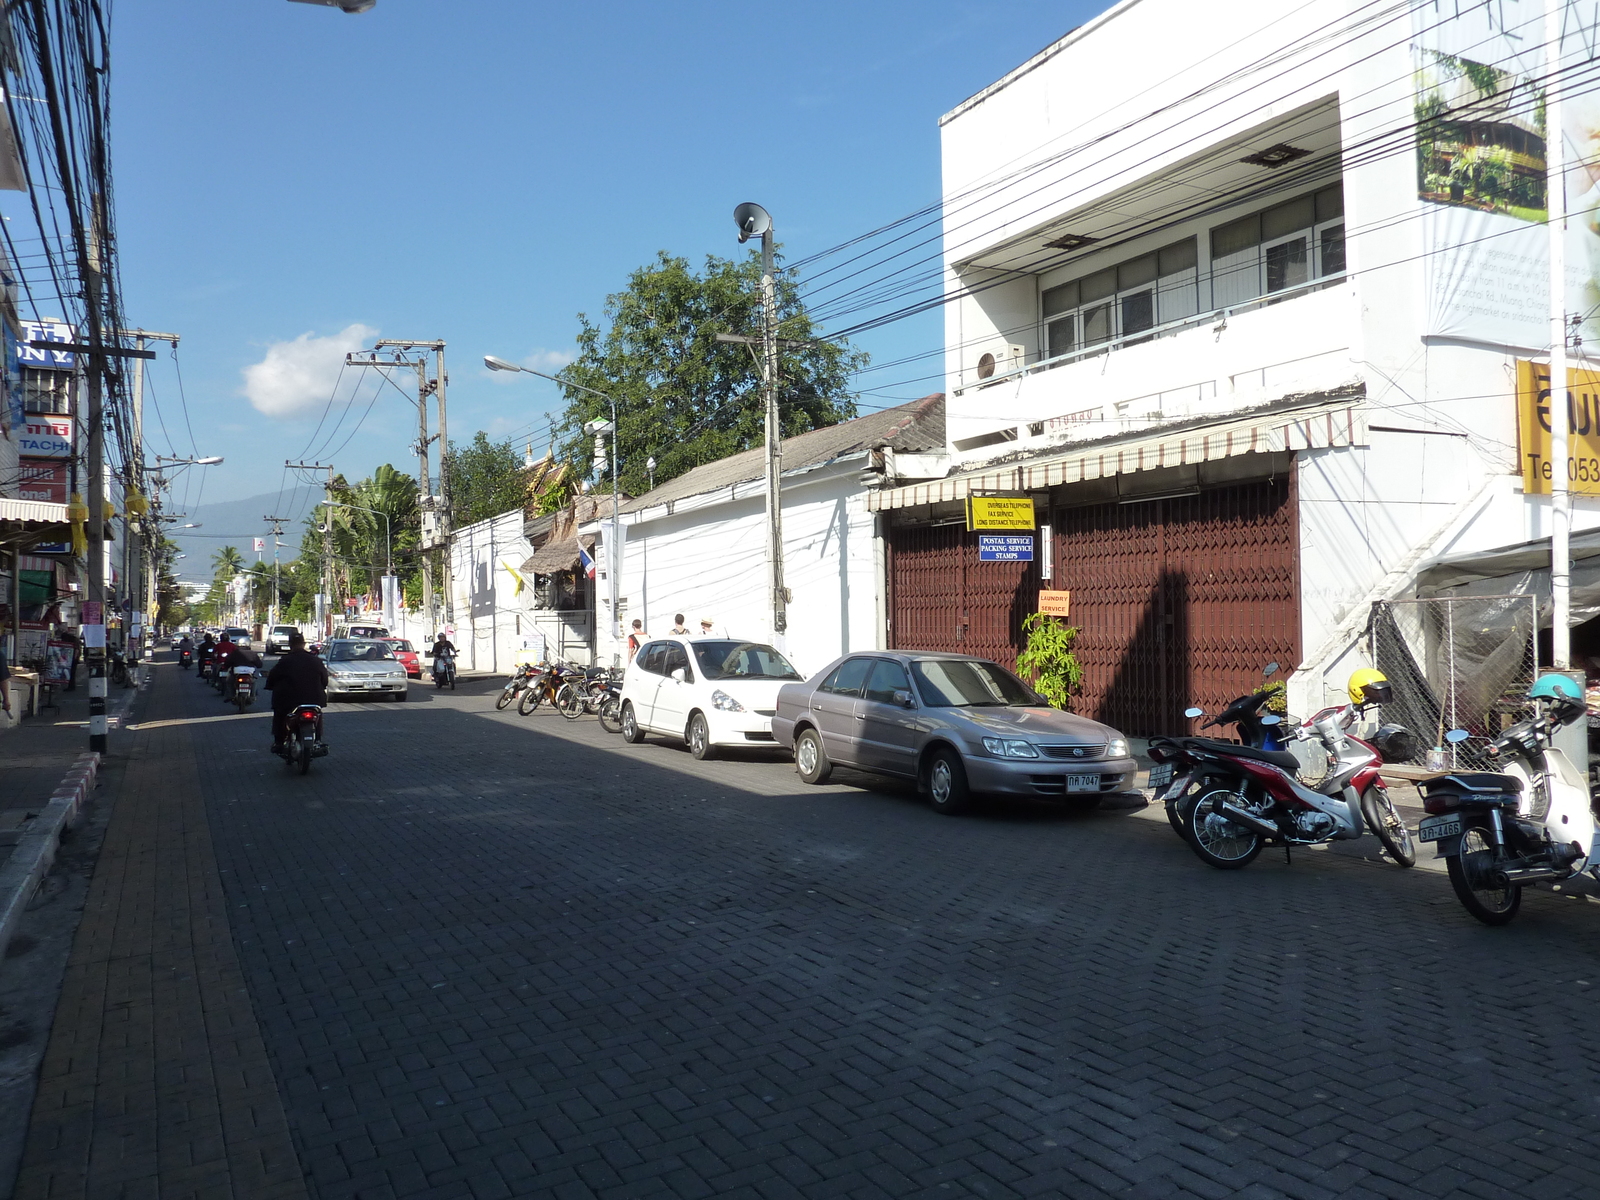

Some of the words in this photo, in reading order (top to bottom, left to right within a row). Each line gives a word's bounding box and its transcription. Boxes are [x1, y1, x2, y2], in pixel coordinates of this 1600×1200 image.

[1520, 254, 1532, 264] and
[1479, 272, 1494, 286] from
[1497, 277, 1505, 288] 11
[1522, 284, 1530, 294] to
[1532, 283, 1541, 295] 10
[1526, 297, 1550, 314] Chiang
[1501, 311, 1510, 320] on
[19, 488, 52, 500] onal
[1081, 776, 1099, 786] 7047
